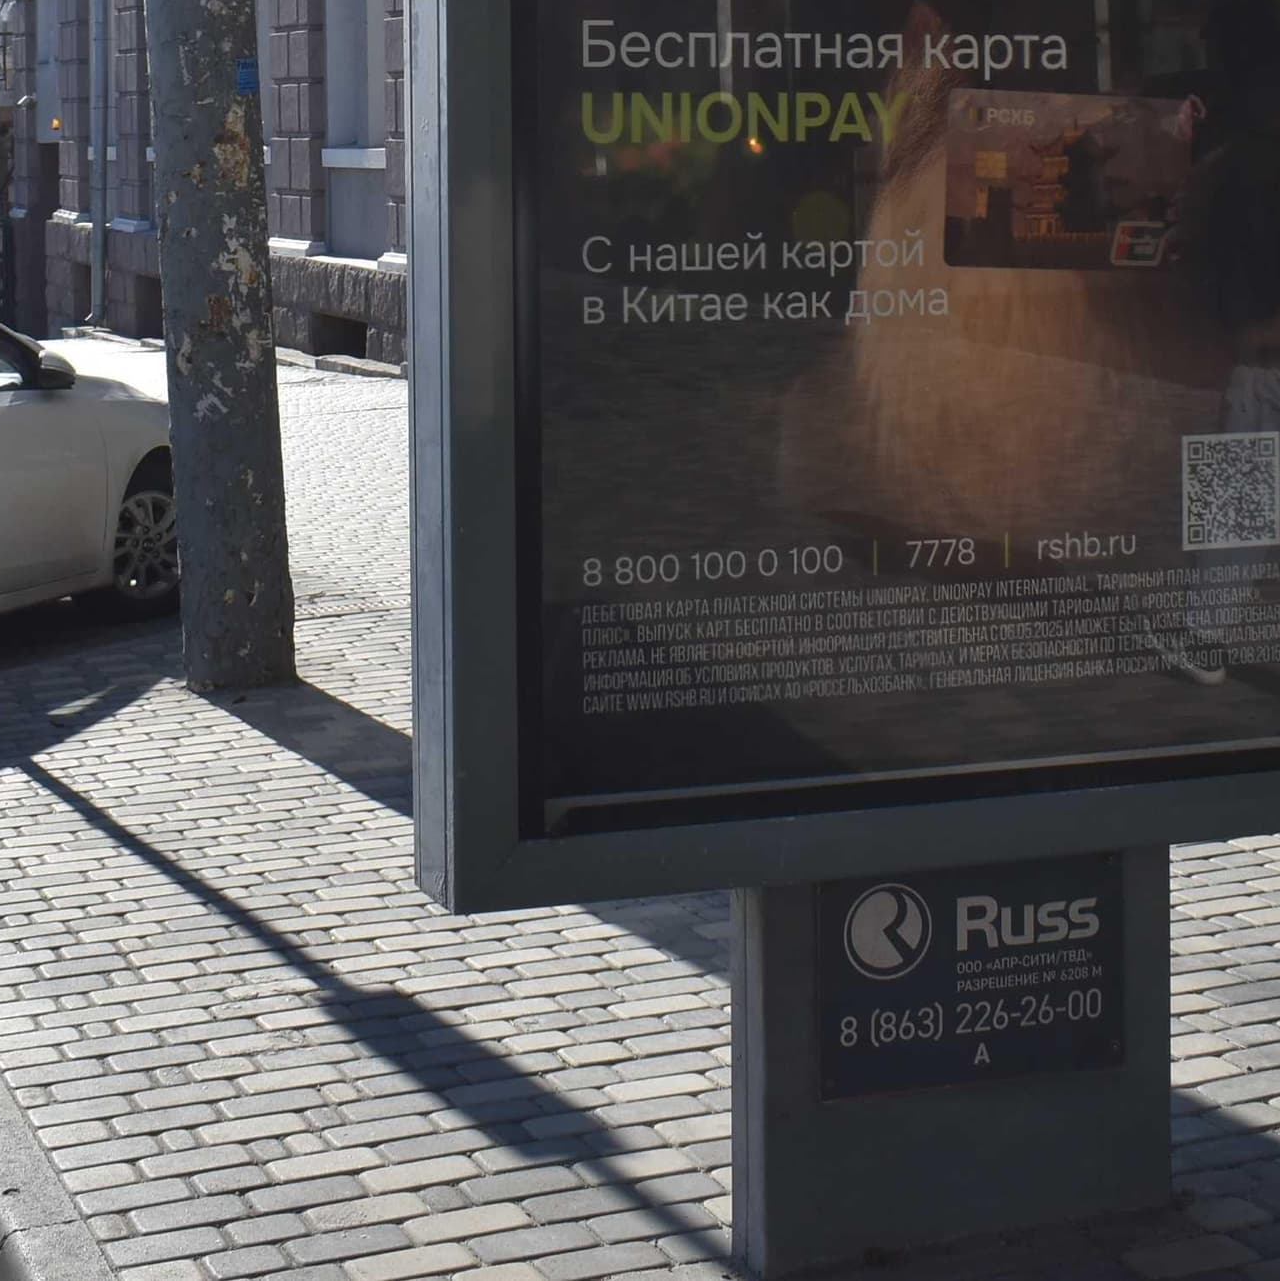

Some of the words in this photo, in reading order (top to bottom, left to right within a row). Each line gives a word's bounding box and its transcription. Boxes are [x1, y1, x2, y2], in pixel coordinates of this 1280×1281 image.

[581, 20, 903, 70] Бесплатная
[923, 29, 1068, 80] карта
[581, 91, 911, 144] UNIONPAY
[582, 236, 613, 275] С
[629, 233, 767, 273] нашей
[782, 228, 925, 277] картой
[582, 295, 605, 325] в
[623, 285, 749, 325] Китае
[763, 288, 833, 320] как
[845, 286, 950, 324] дома
[582, 557, 603, 587] 8
[615, 553, 681, 585] 800
[690, 550, 747, 581] 100
[758, 548, 779, 577] 0
[788, 544, 844, 576] 100
[905, 537, 976, 569] 7778
[1036, 531, 1137, 560] rshb.ru
[637, 621, 692, 644] ВЫПУСК
[697, 619, 731, 640] КАРТ
[735, 614, 811, 638] БЕСПЛАТНО
[827, 607, 924, 630] СООТВЕТСТВИИ
[1052, 595, 1120, 617] ТАРИФАМИ
[666, 597, 710, 619] КАРТА
[714, 591, 796, 616] ПЛАТЕЖНОЙ
[800, 590, 864, 611] СИСТЕМЫ
[933, 582, 993, 603] UNIONPAY
[1097, 569, 1164, 591] ТАРИФНЫЙ
[1168, 568, 1200, 586] ПЛАН
[584, 668, 673, 691] ИНФОРМАЦИЯ
[694, 662, 758, 685] УСЛОВИЯХ
[970, 643, 1010, 663] МЕРАХ
[1011, 638, 1099, 661] БЕЗОПАСНОСТИ
[651, 645, 666, 665] НЕ
[669, 641, 734, 663] ЯВЛЯЕТСЯ
[799, 632, 886, 655] ИНФОРМАЦИЯ
[583, 692, 624, 714] САЙТЕ
[929, 666, 1011, 689] ГЕНЕРАЛЬНАЯ
[1014, 661, 1074, 682] ЛИЦЕНЗИЯ
[1076, 659, 1114, 678] БАНКА
[956, 895, 1100, 951] Russ
[956, 972, 1039, 992] РАЗРЕШЕНИЕ
[1042, 969, 1056, 984] №
[839, 1016, 858, 1047] 8
[871, 1002, 944, 1047] (863)
[955, 988, 1102, 1034] 226-26-00
